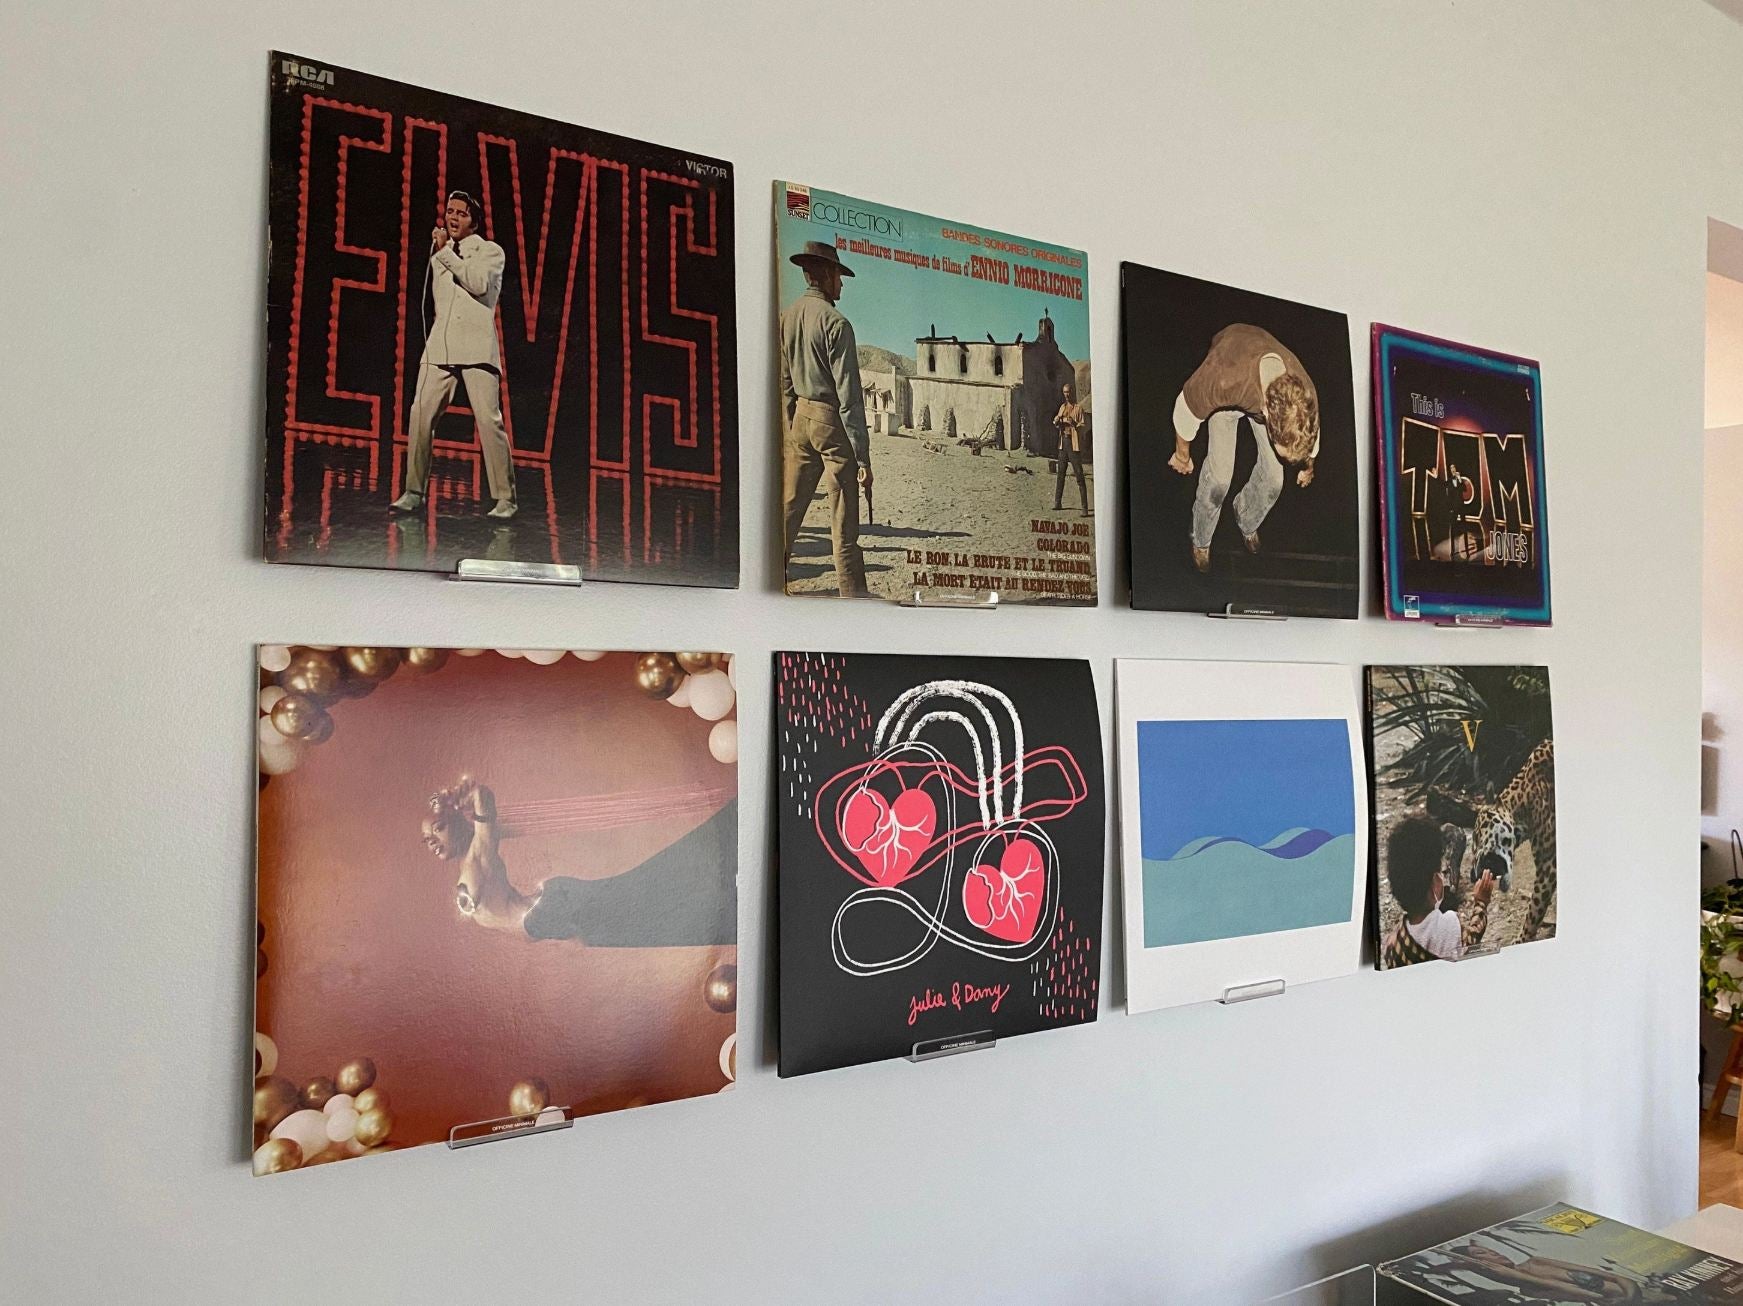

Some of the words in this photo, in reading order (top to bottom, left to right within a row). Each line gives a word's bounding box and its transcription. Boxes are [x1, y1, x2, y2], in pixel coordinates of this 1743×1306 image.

[281, 60, 335, 86] RCA
[685, 160, 728, 179] VICTOR
[787, 208, 810, 220] SUNSET
[812, 202, 902, 238] COLLECTION
[942, 227, 981, 247] BANDES
[983, 237, 1030, 257] SONORES
[1030, 248, 1083, 269] ORIGINALES
[835, 233, 847, 251] les
[849, 238, 892, 260] meilleures
[894, 248, 930, 270] musiques
[931, 253, 941, 271] de
[942, 256, 962, 275] films
[1013, 263, 1084, 301] MORRICONE
[285, 95, 722, 483] ELVIS
[1410, 392, 1434, 417] This
[1434, 398, 1445, 419] is
[1401, 416, 1534, 528] TOM
[1030, 519, 1070, 536] NAVAJO
[1071, 523, 1090, 537] JOE
[1037, 538, 1090, 554] COLORADO
[1487, 530, 1529, 563] JONES
[907, 549, 921, 564] LE
[953, 552, 970, 568] LA
[973, 554, 1011, 570] BRUTE
[1014, 556, 1029, 571] ET
[1031, 557, 1046, 573] LE
[913, 571, 929, 587] LA
[932, 572, 966, 588] MORT
[1004, 576, 1019, 590] AU
[1022, 578, 1065, 593] RENDEZ
[1065, 580, 1092, 595] VOUS
[1460, 719, 1483, 753] V
[908, 989, 946, 1025] Julie
[951, 982, 961, 1011] &
[964, 983, 1010, 1013] Dany
[1661, 1273, 1700, 1291] RAY
